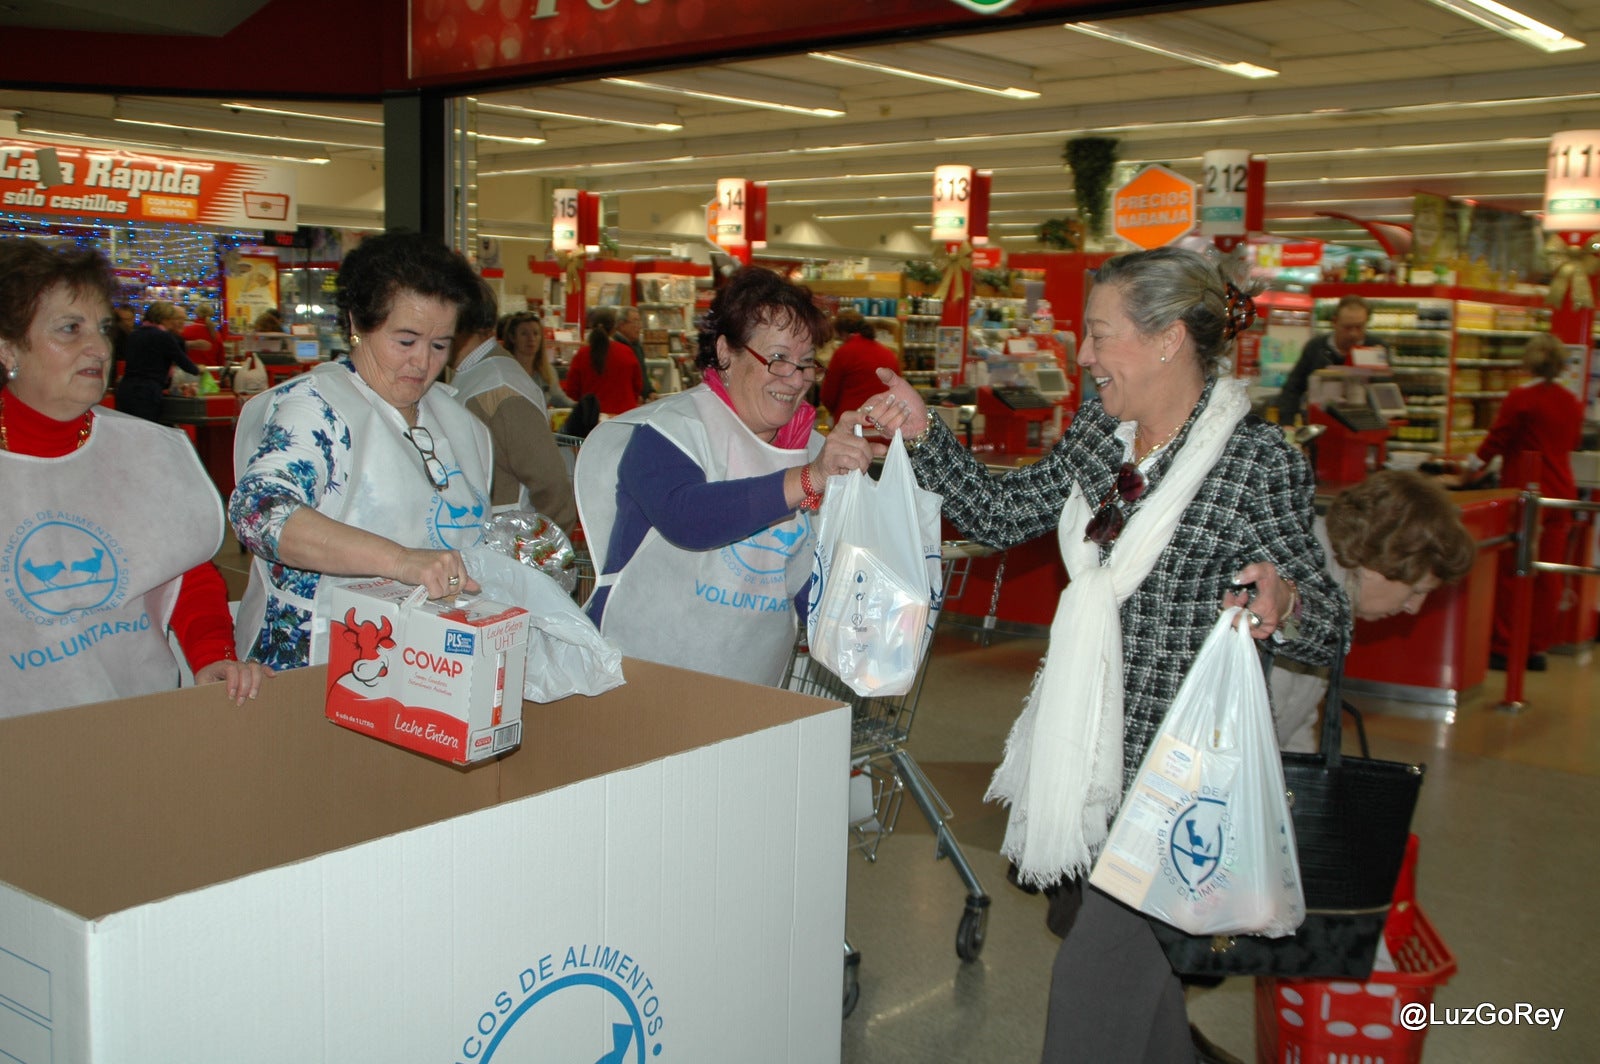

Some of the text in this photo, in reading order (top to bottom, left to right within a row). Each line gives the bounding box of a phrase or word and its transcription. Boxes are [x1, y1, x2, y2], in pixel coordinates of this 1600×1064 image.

[84, 156, 200, 198] Rápida
[4, 188, 128, 213] sólo cestillos
[560, 198, 577, 218] 15
[727, 189, 744, 210] 14
[1118, 191, 1189, 210] PRECIOS
[1117, 210, 1188, 228] NARANJA
[1, 510, 123, 572] BANCOS DE ALIMENTOS
[5, 588, 54, 626] BANCOS
[695, 579, 792, 612] VOLUNTAR
[10, 612, 151, 671] VOLUNTARIO
[447, 632, 462, 648] PLS
[495, 632, 516, 651] UHT
[403, 647, 463, 678] COVAP
[394, 713, 424, 737] Leche
[425, 723, 459, 749] Entera
[1157, 828, 1177, 884] BANCOS
[518, 954, 554, 994] DE
[562, 944, 663, 1037] ALIMENTOS
